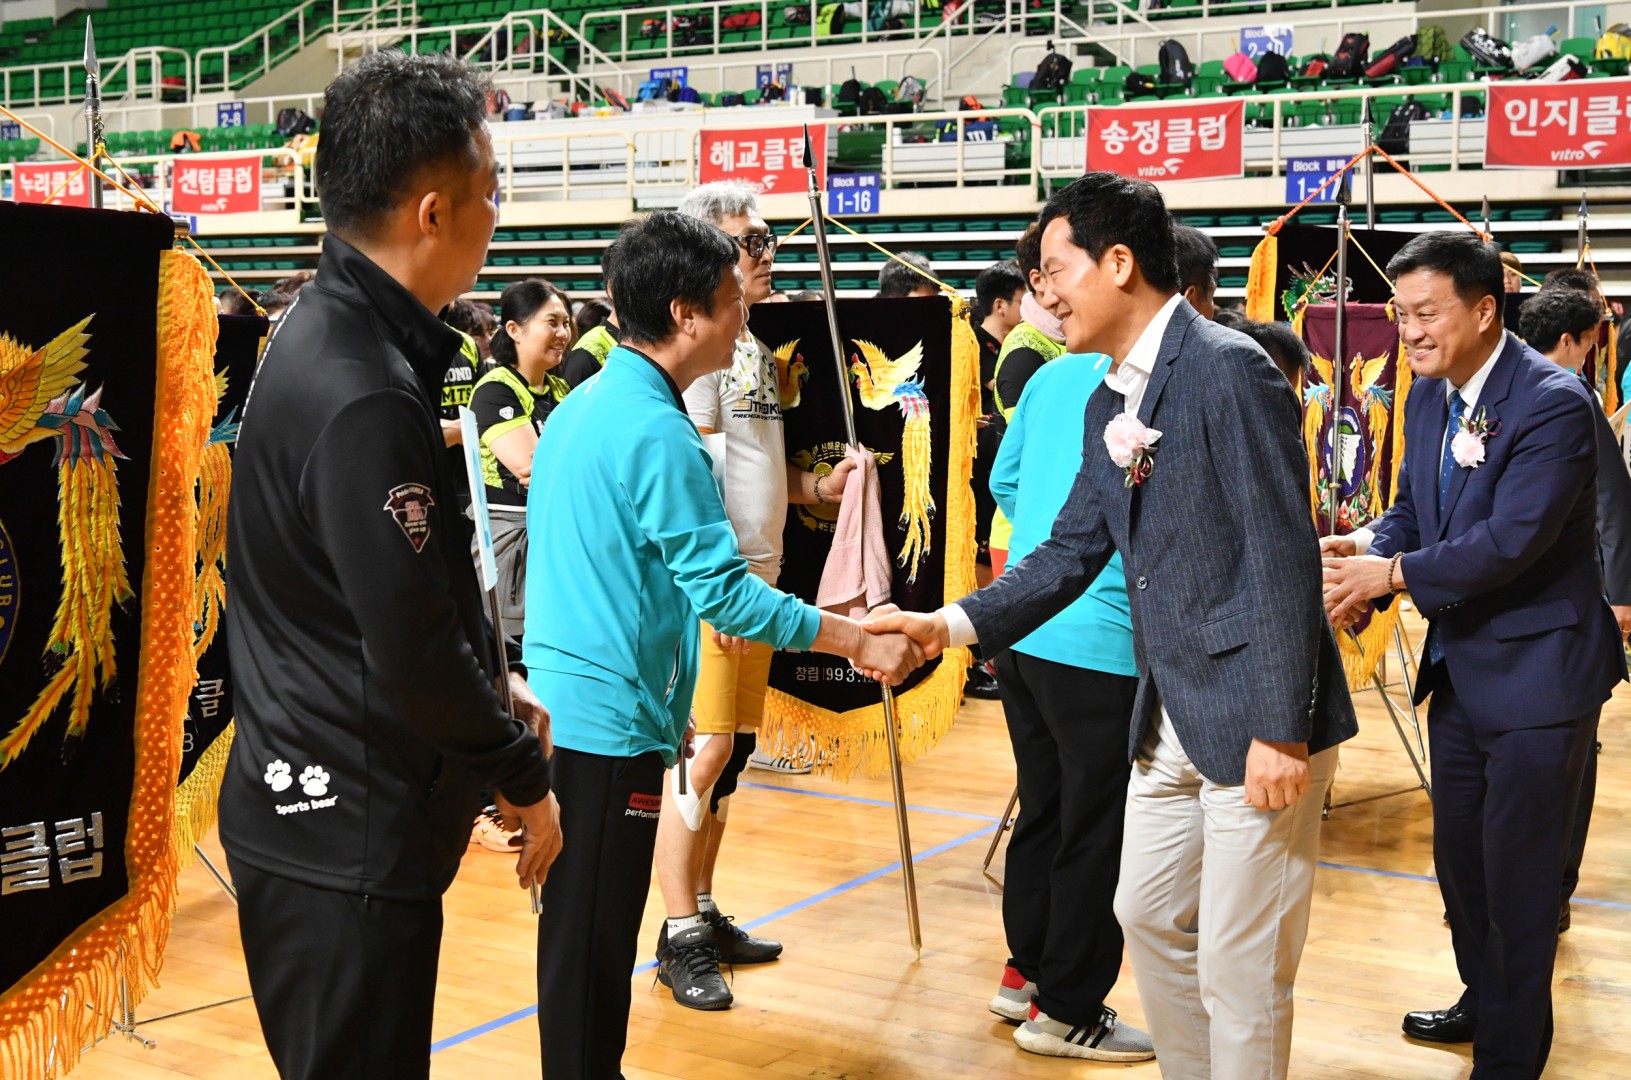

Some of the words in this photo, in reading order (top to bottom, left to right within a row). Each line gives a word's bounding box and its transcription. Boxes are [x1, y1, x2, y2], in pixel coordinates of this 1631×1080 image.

[1504, 95, 1631, 136] 인지클
[1100, 113, 1227, 155] 송정클럽
[1293, 160, 1320, 172] Block
[1551, 148, 1585, 161] vitro
[178, 166, 252, 196] 센텀클럽
[1138, 164, 1166, 177] vitro
[20, 171, 85, 198] 누리클럽
[837, 190, 871, 213] 1-16
[795, 666, 819, 682] 창립
[311, 795, 339, 810] bear
[0, 811, 104, 896] 클럽
